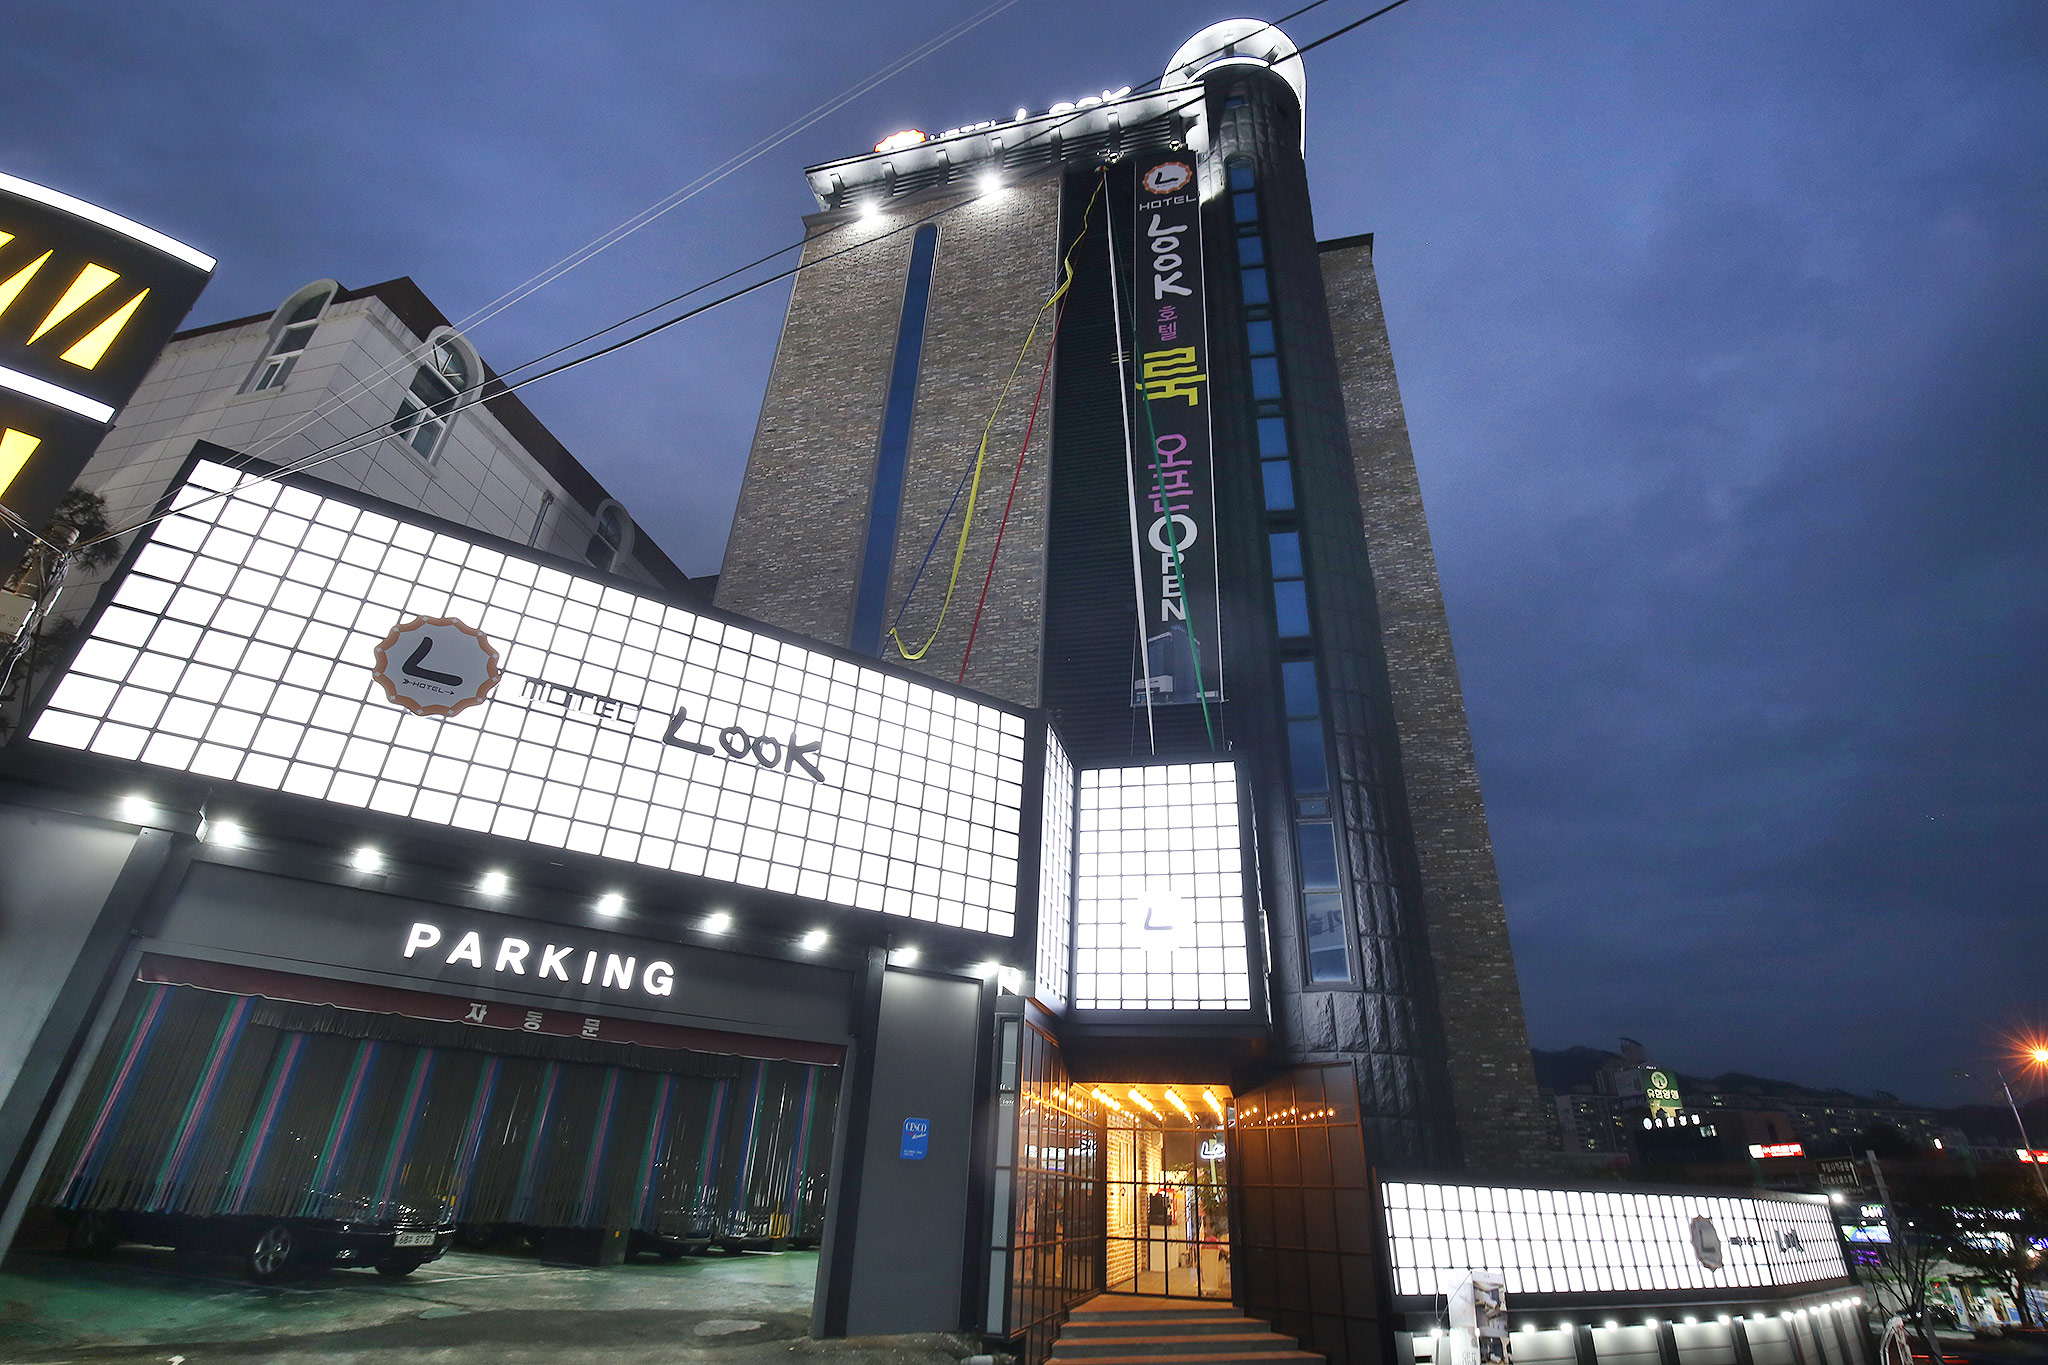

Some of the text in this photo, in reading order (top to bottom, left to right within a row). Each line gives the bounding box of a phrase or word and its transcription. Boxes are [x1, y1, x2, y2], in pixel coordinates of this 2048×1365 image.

[1139, 195, 1197, 211] HOTEL
[1147, 213, 1193, 300] LOOK
[1157, 305, 1178, 341] 호텔
[1135, 346, 1207, 407] 룩
[1147, 433, 1194, 513] 오픈
[1148, 514, 1198, 622] OPEN
[412, 681, 444, 694] HOTEL
[663, 706, 826, 783] LOOK
[402, 921, 677, 998] PARKING
